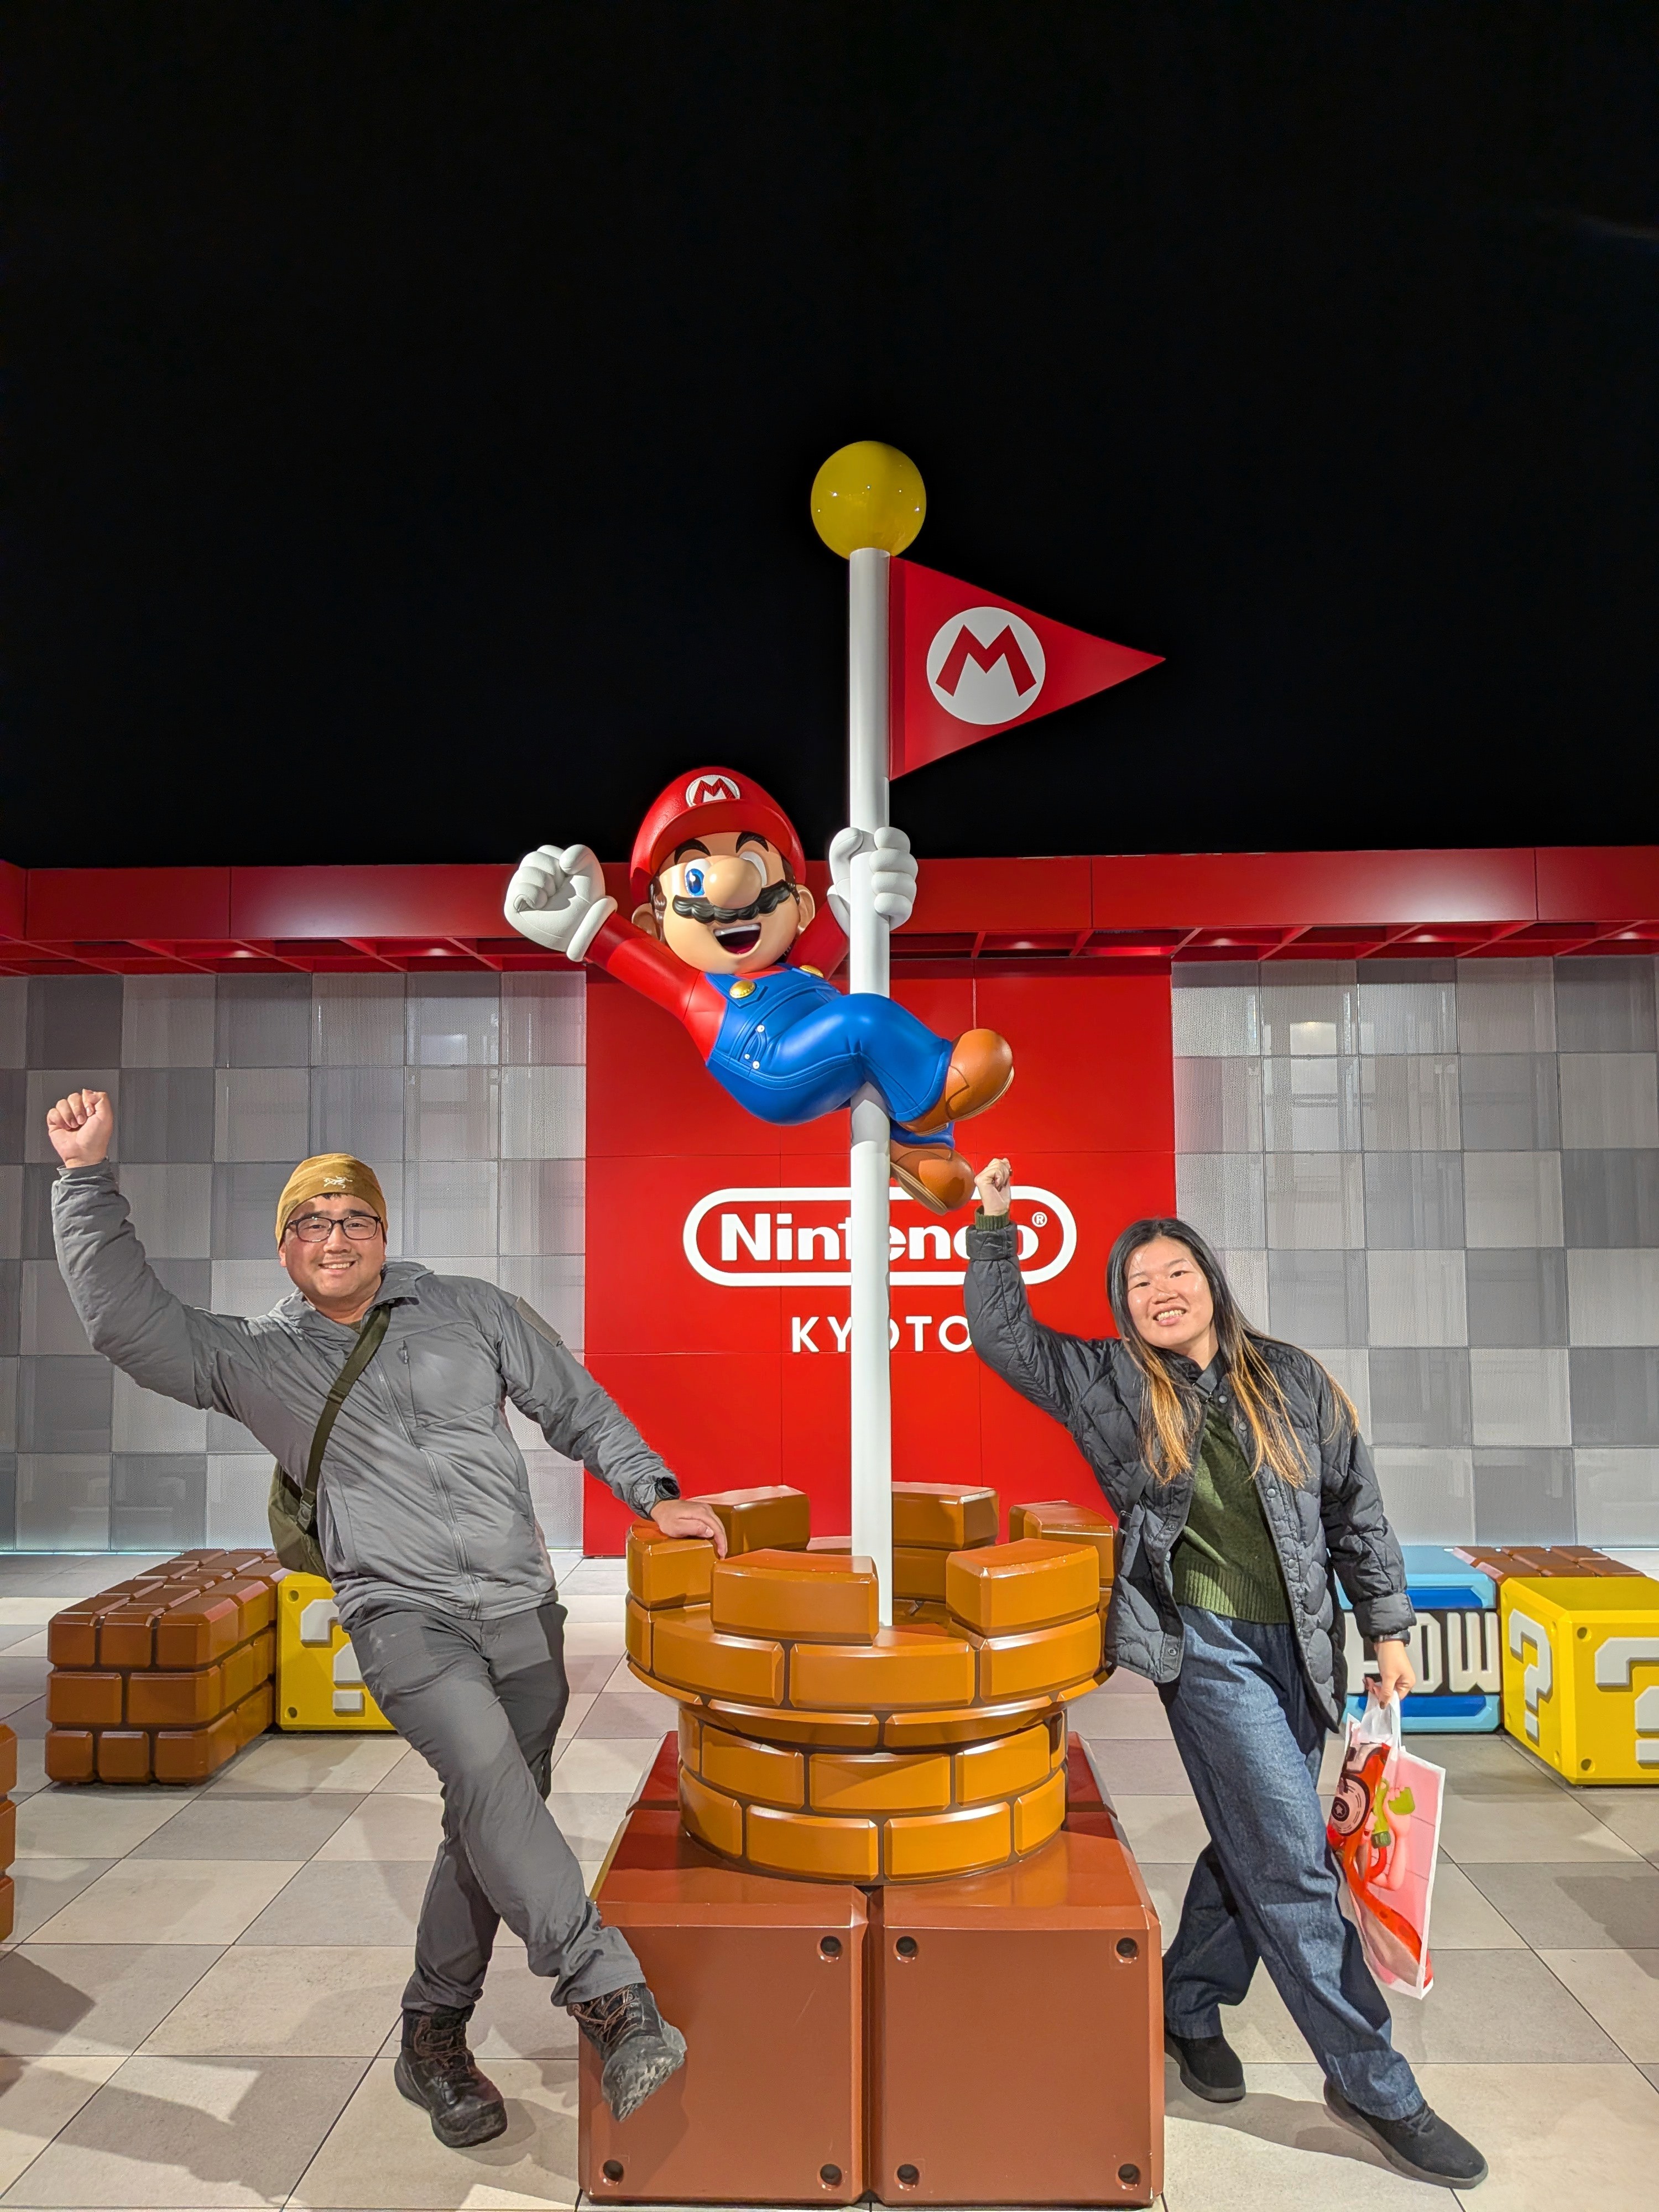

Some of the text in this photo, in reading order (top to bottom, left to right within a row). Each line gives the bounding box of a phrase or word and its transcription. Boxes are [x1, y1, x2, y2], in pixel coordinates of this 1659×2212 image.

[935, 624, 1037, 697] M
[692, 778, 737, 804] M
[791, 1315, 972, 1353] KYTO
